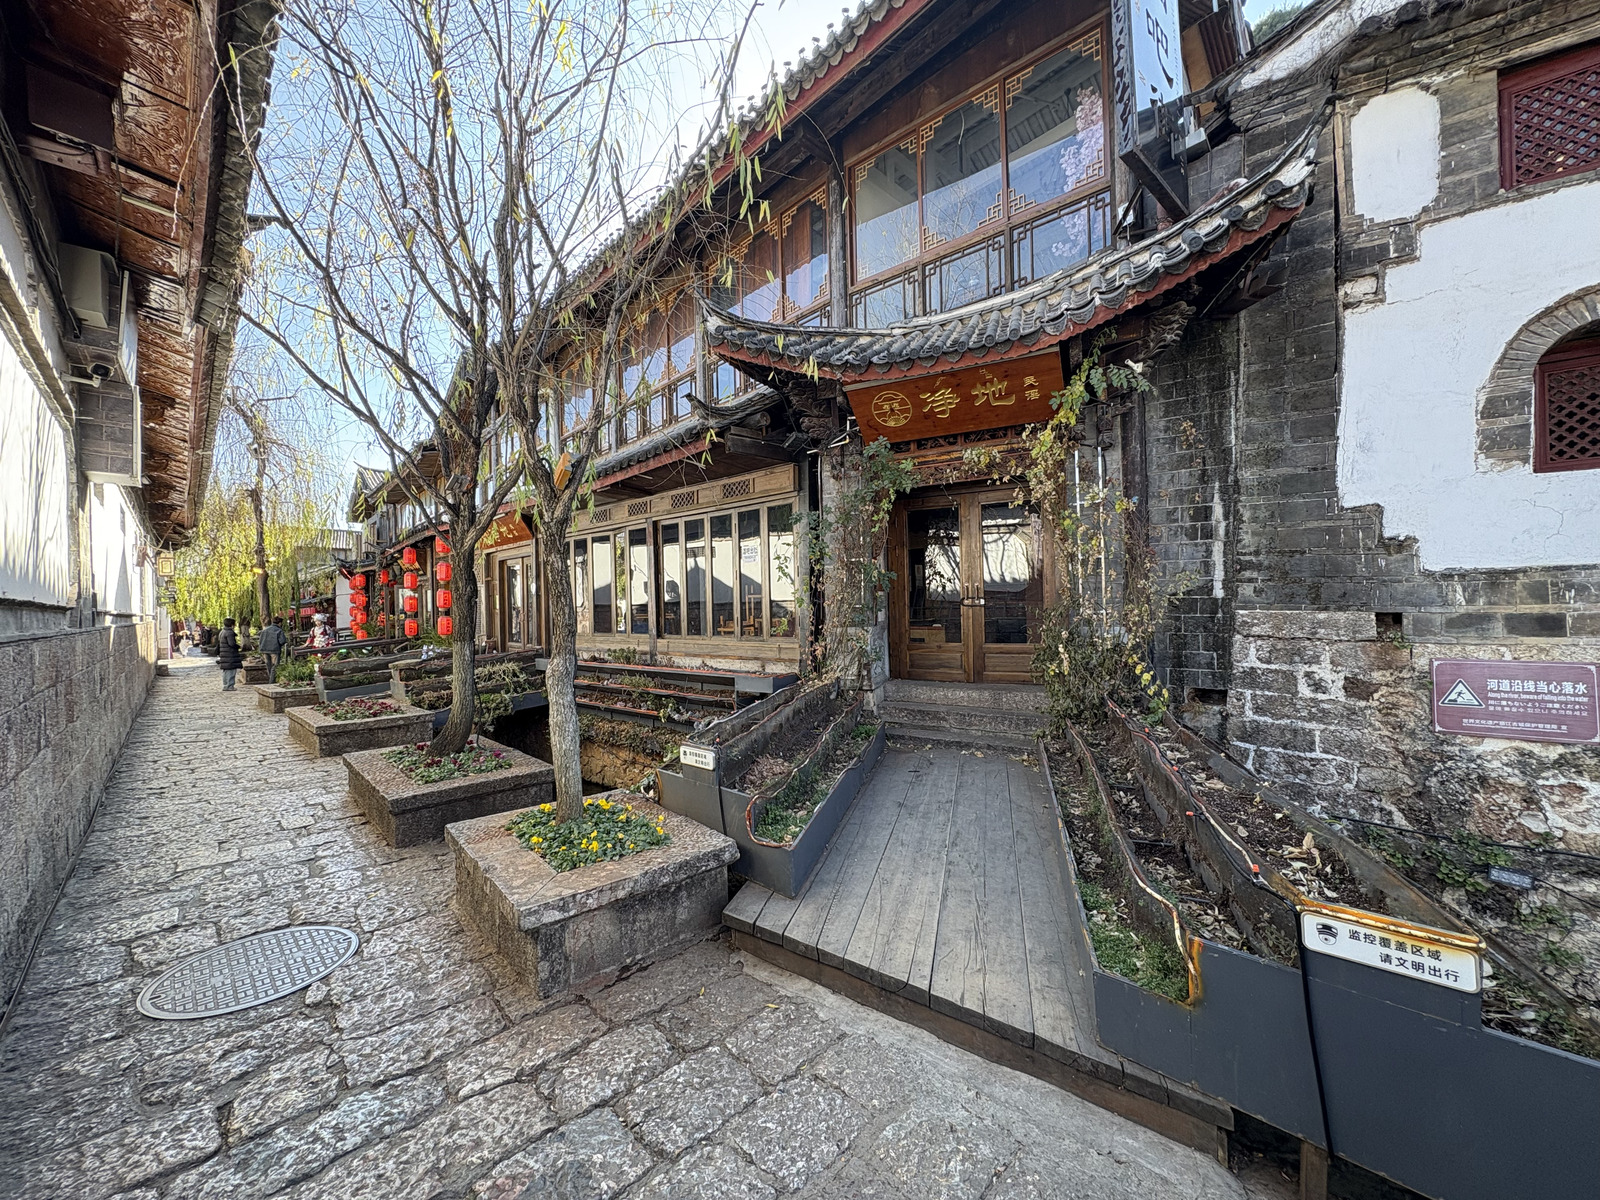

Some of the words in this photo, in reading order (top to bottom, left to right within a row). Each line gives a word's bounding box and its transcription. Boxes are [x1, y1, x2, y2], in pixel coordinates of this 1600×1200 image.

[1487, 679, 1588, 694] 河道沿线当心落水
[1348, 929, 1442, 962] 监控覆盖区域
[1379, 952, 1460, 982] 请文明出行
